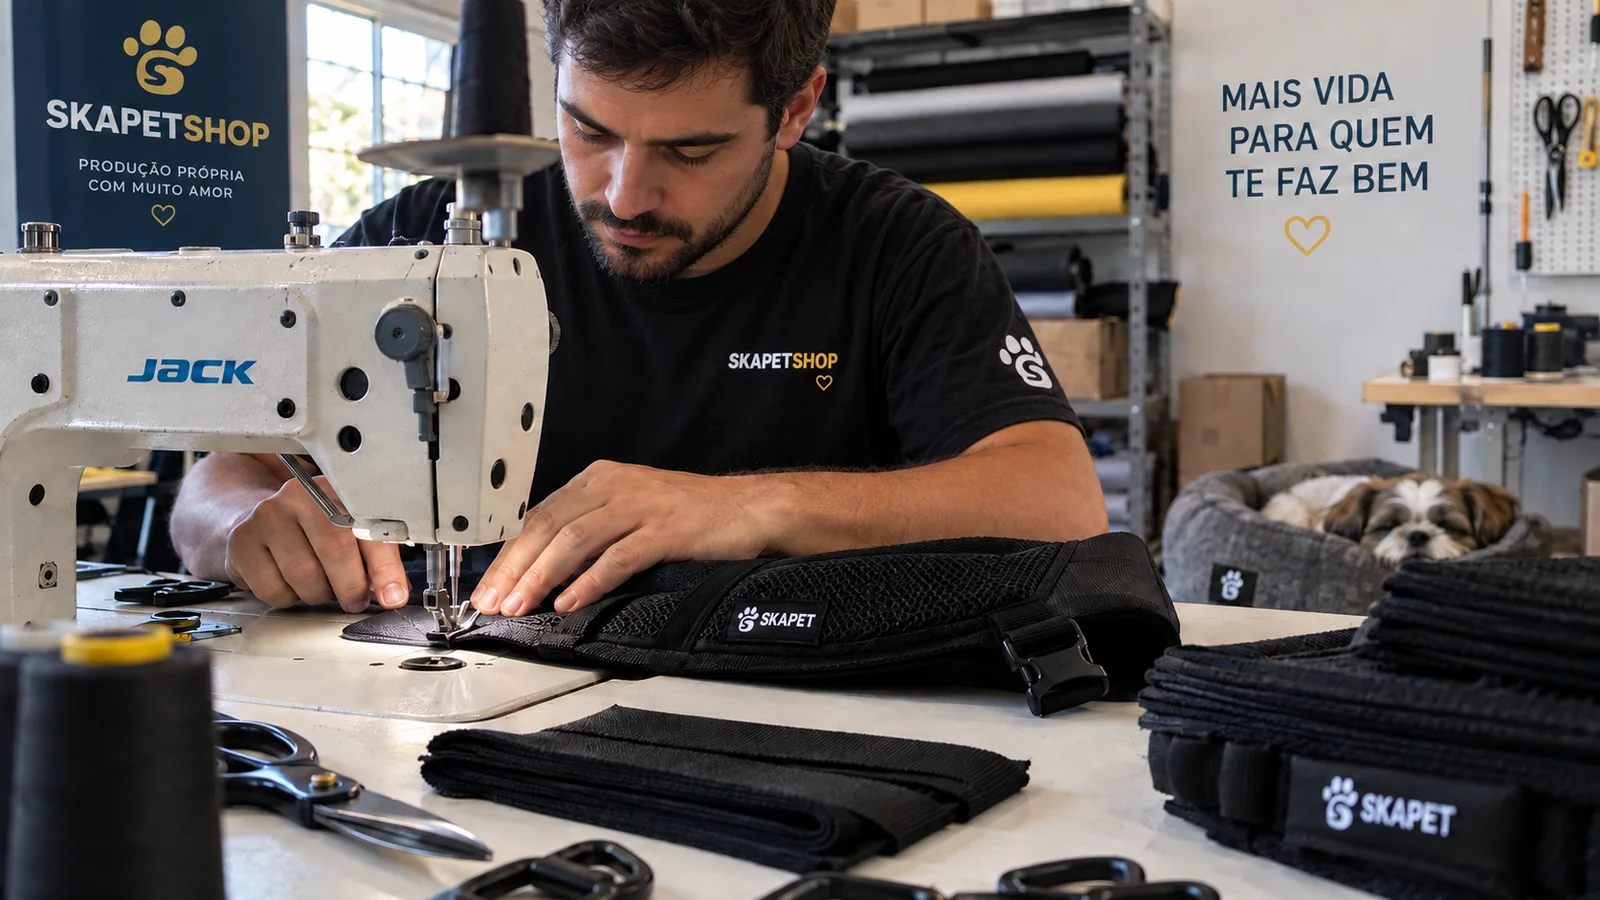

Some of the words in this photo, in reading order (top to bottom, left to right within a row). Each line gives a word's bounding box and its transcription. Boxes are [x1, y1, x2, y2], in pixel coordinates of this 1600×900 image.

[1222, 78, 1302, 112] MAIS
[1313, 71, 1395, 105] VIDA
[46, 99, 270, 147] SKAPETSHOP
[1230, 122, 1318, 154] PARA
[1330, 114, 1434, 152] QUEM
[78, 158, 172, 178] PRODUÇÃO
[177, 165, 245, 182] PRÓPRIA
[1225, 168, 1264, 198] TE
[1277, 165, 1339, 196] FAZ
[1353, 161, 1428, 194] BEM
[88, 179, 126, 193] COM
[132, 182, 183, 196] MUITO
[188, 185, 233, 199] AMOR
[728, 352, 839, 369] SKAPETSHOP
[760, 612, 817, 628] SKAPET
[1360, 792, 1457, 838] SKAPET
